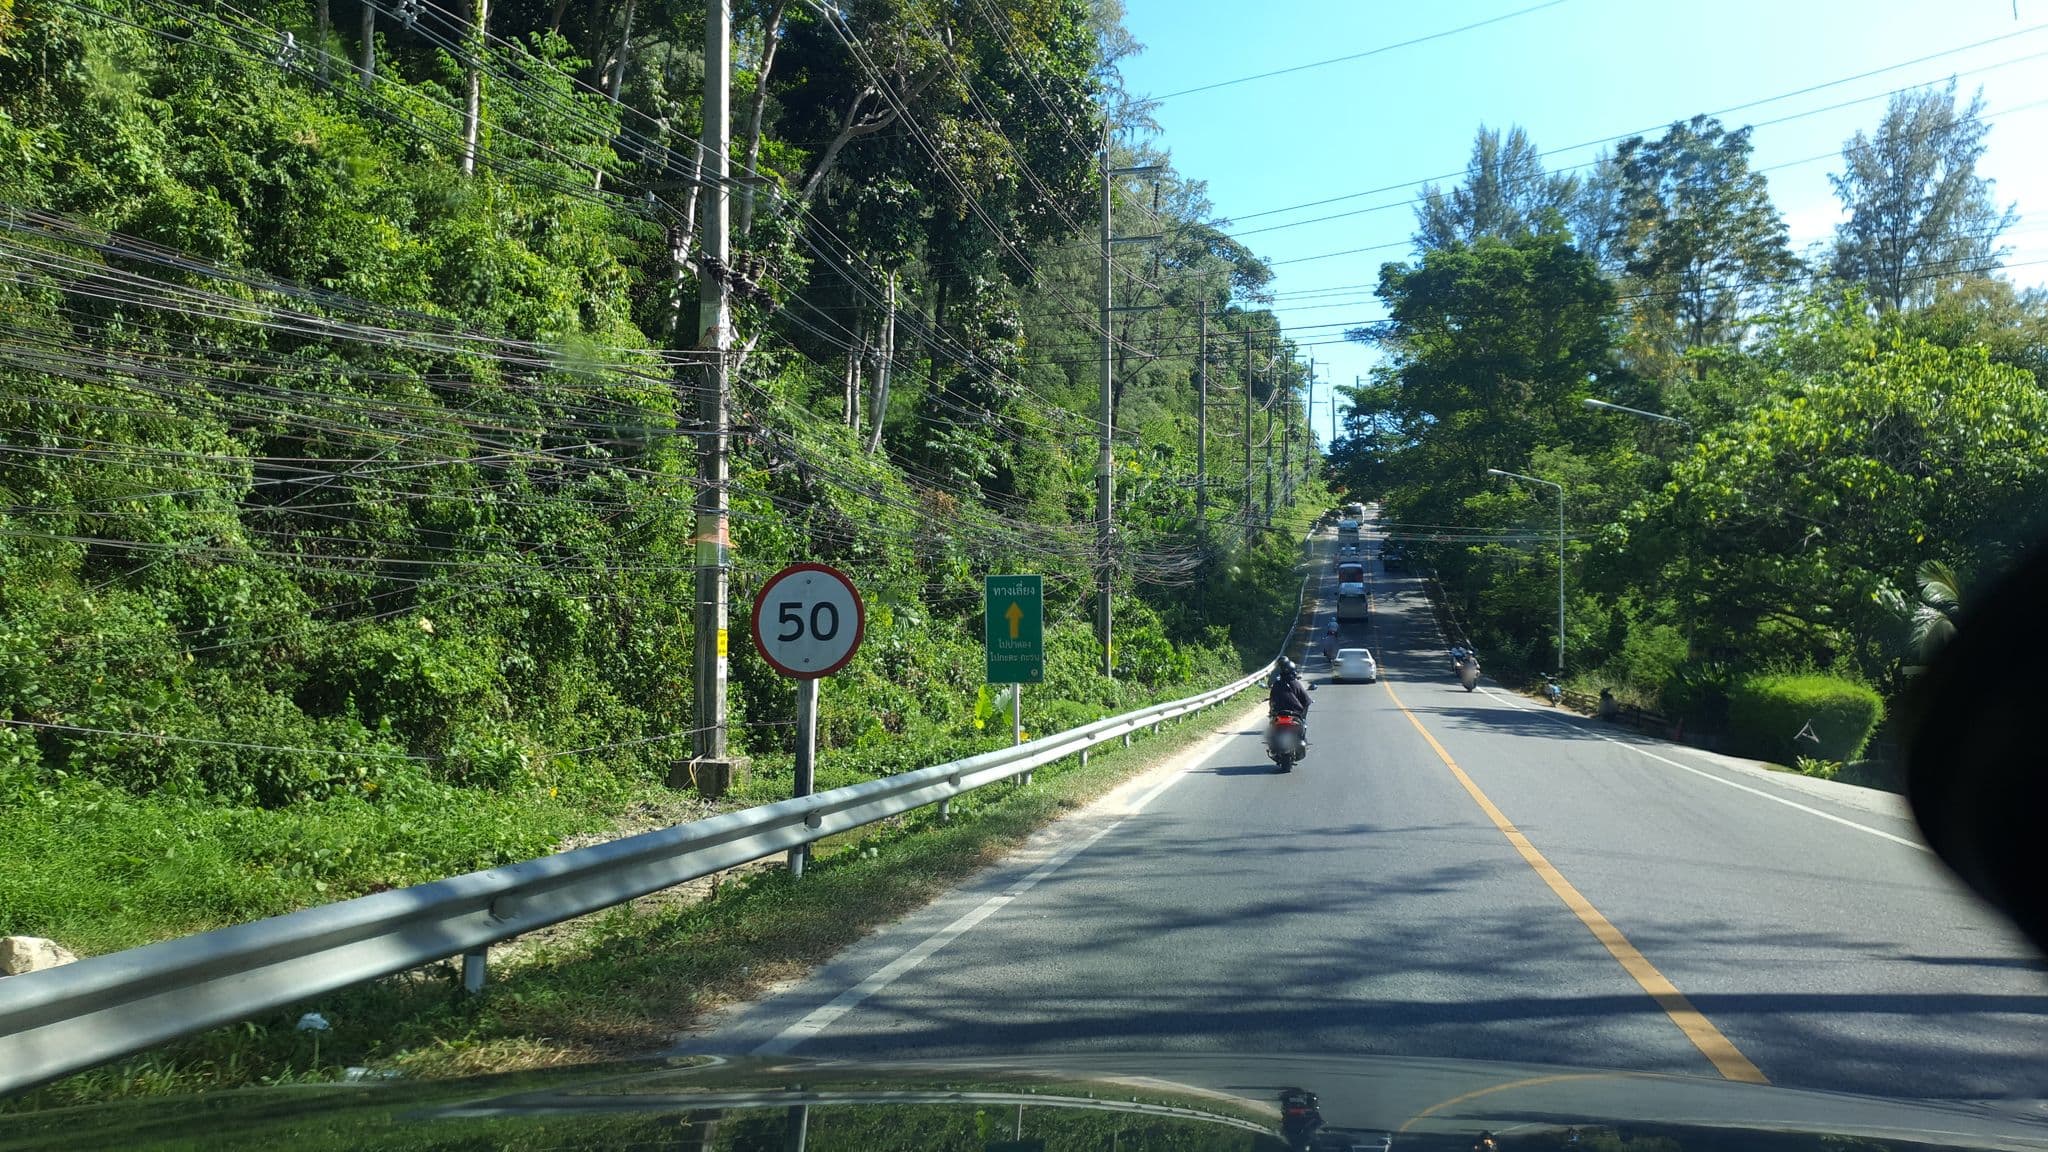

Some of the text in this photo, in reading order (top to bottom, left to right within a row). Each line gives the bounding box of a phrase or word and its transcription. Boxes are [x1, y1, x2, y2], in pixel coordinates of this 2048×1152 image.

[993, 580, 1036, 596] ทางเลี่ยง
[777, 601, 839, 642] 50
